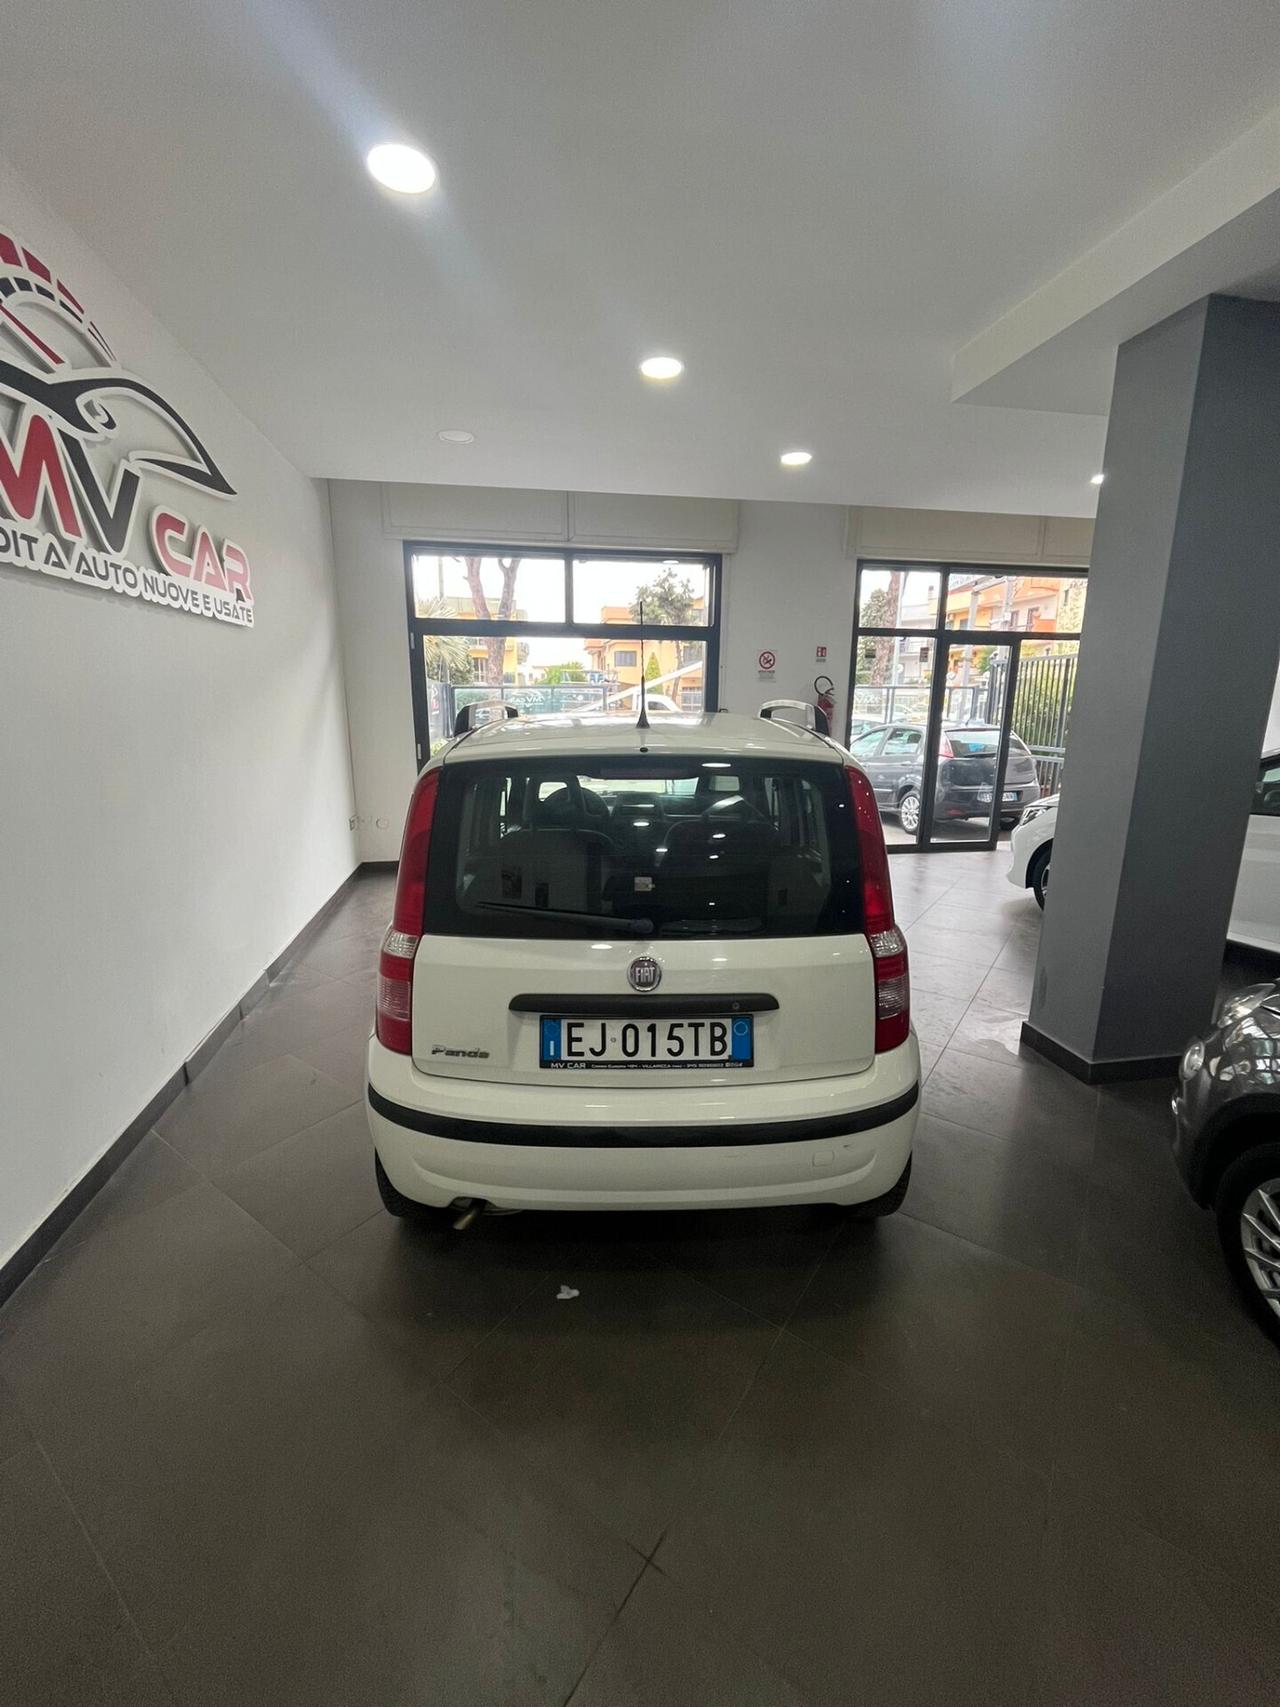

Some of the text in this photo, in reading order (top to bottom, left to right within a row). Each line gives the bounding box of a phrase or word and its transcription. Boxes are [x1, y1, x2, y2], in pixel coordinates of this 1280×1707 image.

[0, 414, 252, 601] MV CAR
[75, 551, 138, 589] AUTO
[142, 573, 200, 607] NUOVE
[202, 594, 212, 611] E
[213, 597, 253, 623] USATE
[635, 966, 656, 983] FIAT
[431, 1044, 491, 1059] Panda
